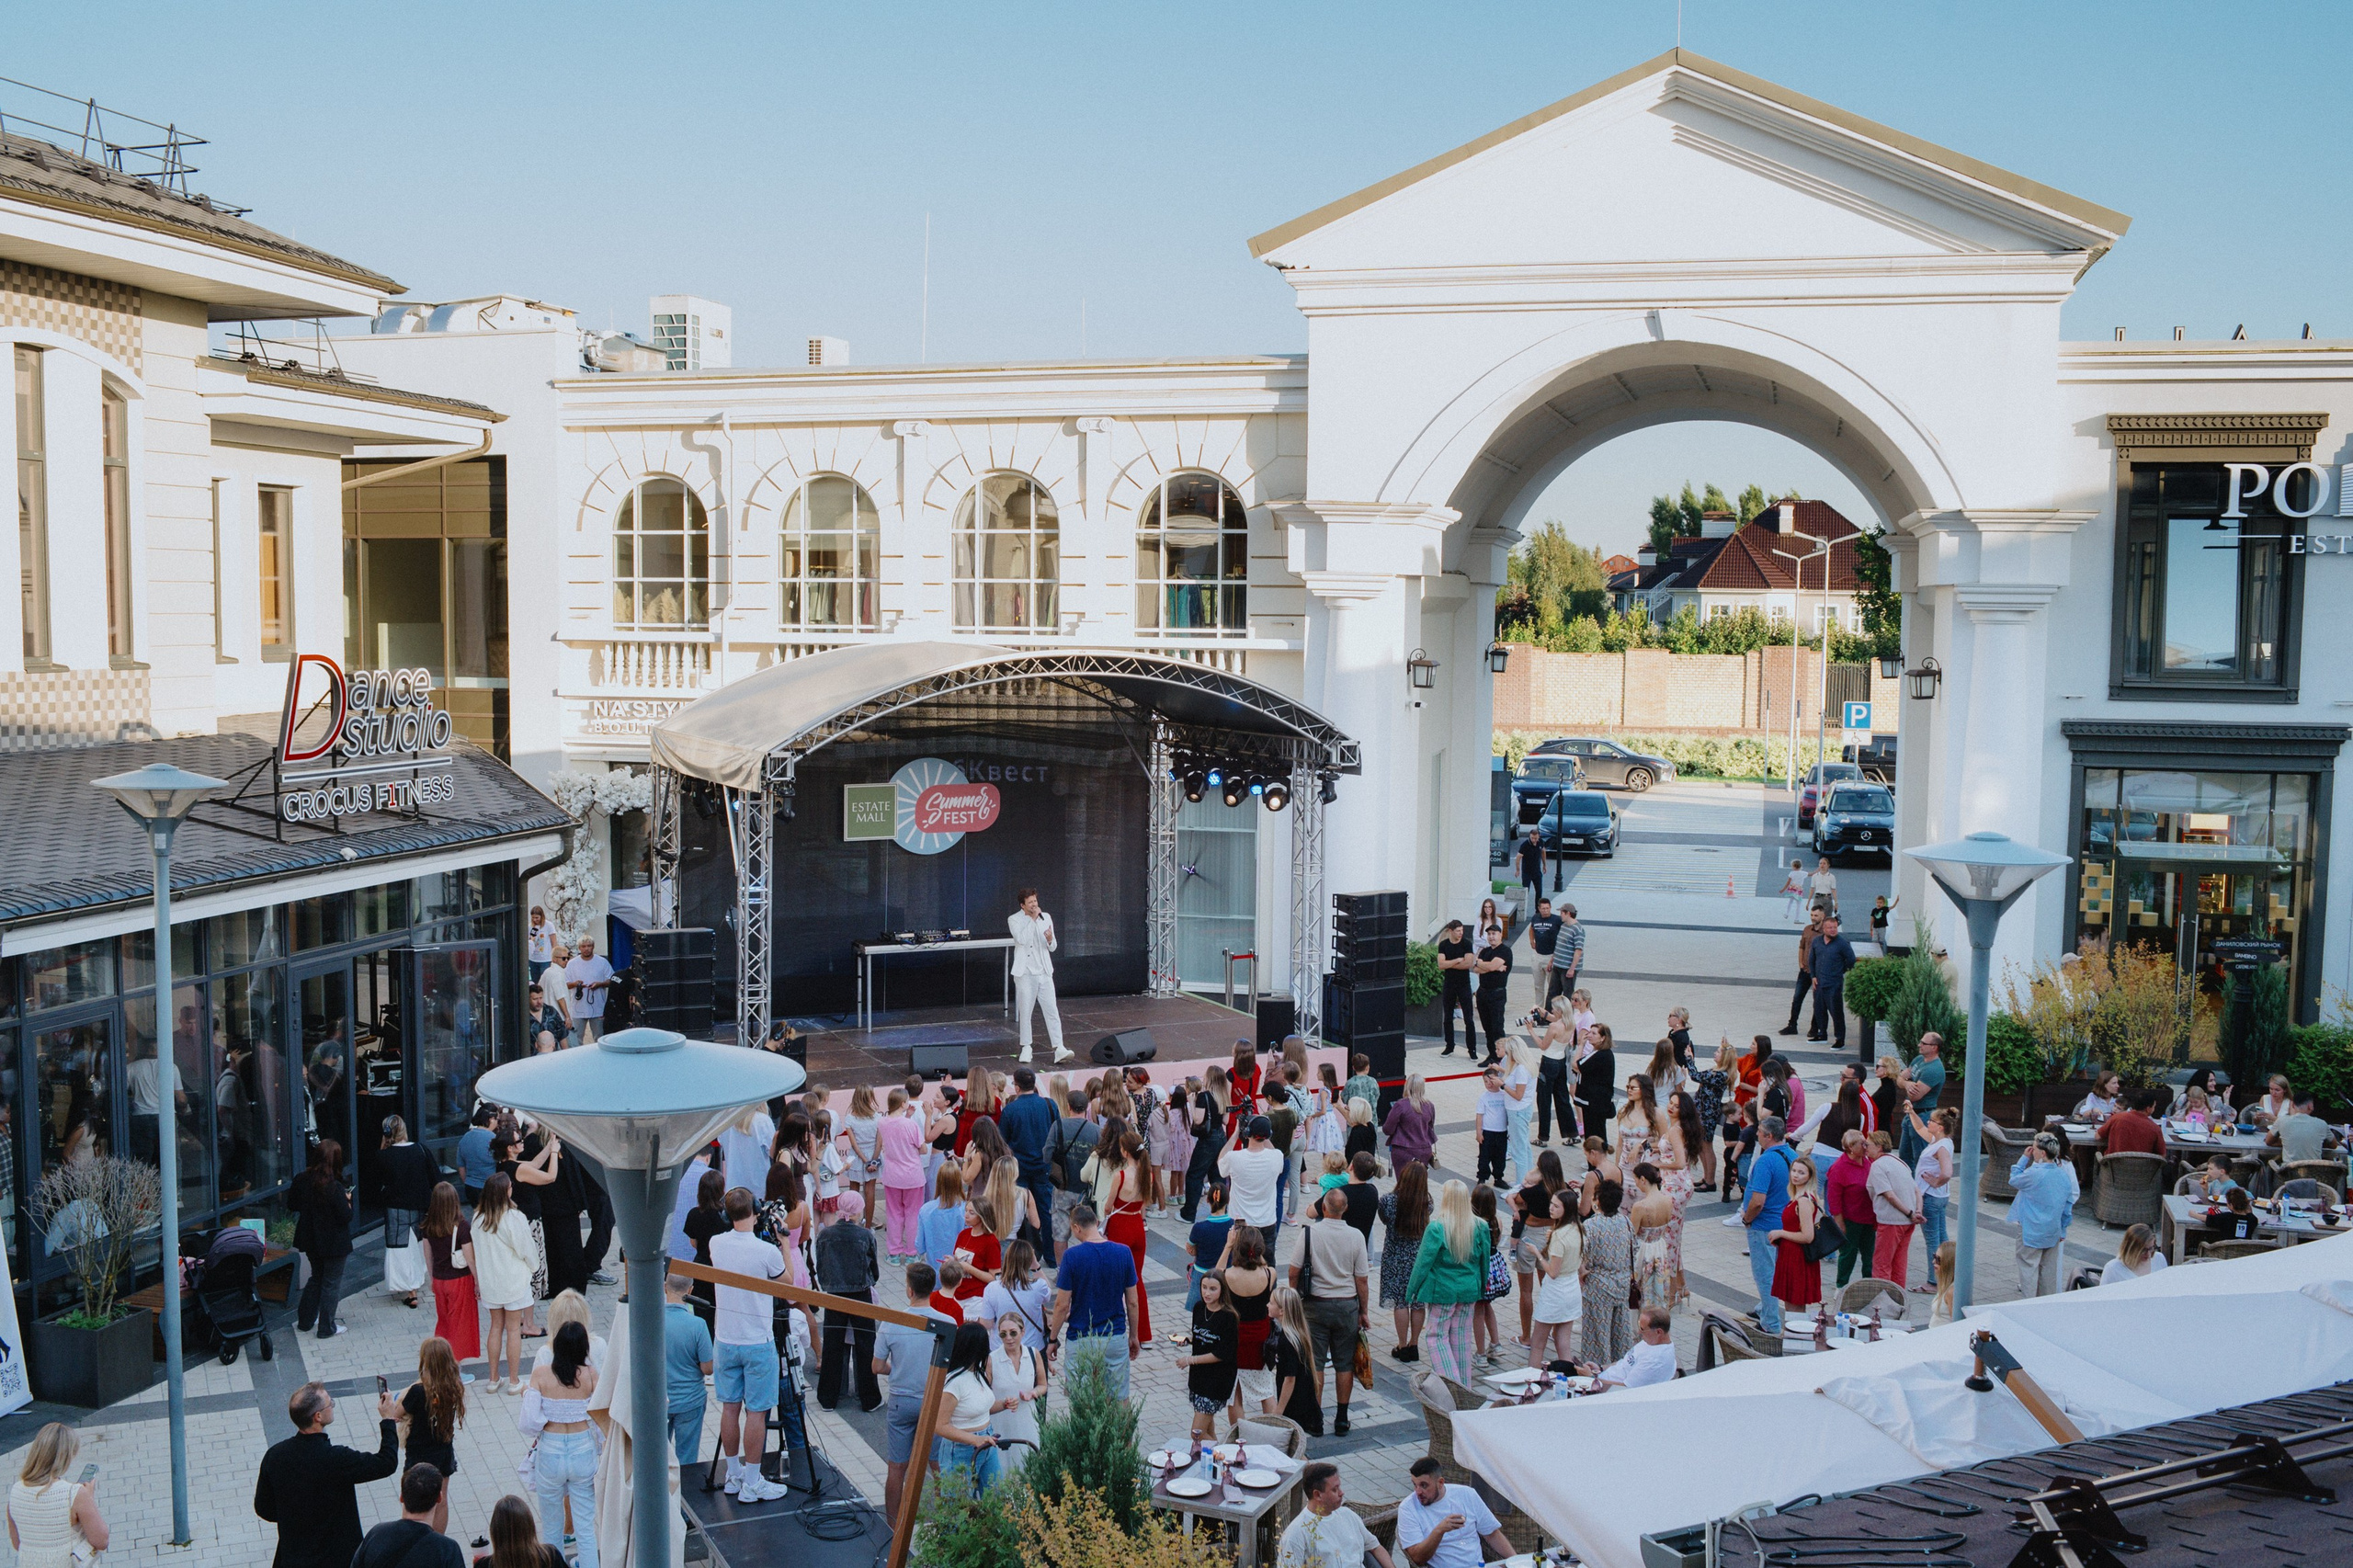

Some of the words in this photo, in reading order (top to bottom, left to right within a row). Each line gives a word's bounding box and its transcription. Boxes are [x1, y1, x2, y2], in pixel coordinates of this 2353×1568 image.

[2221, 462, 2353, 517] PO
[281, 653, 436, 765] Dance
[1850, 704, 1868, 727] P
[342, 702, 452, 758] studio
[282, 783, 372, 823] CROCUS
[851, 801, 891, 812] ESTATE
[856, 812, 886, 823] MALL
[925, 786, 991, 825] Summer
[943, 812, 977, 824] FEST
